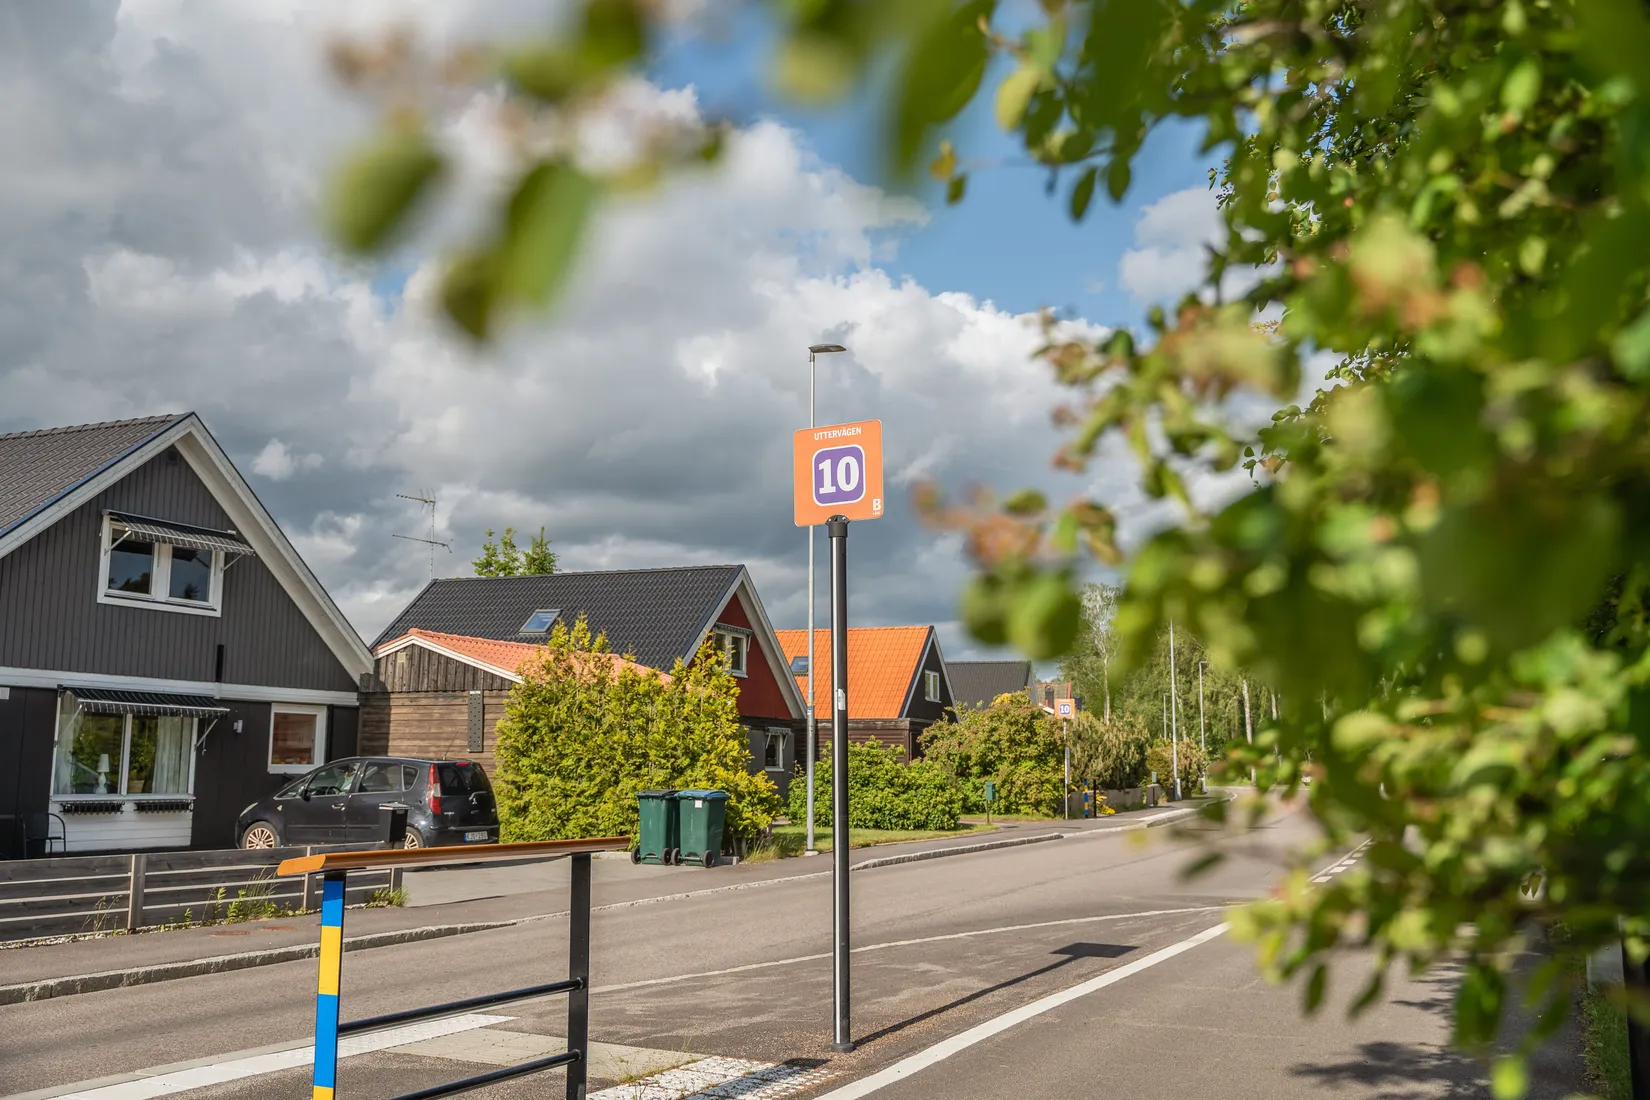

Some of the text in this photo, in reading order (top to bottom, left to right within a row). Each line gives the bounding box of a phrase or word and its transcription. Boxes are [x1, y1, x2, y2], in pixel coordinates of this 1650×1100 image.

[818, 456, 860, 494] 10
[873, 498, 881, 511] B
[1060, 705, 1070, 713] 10
